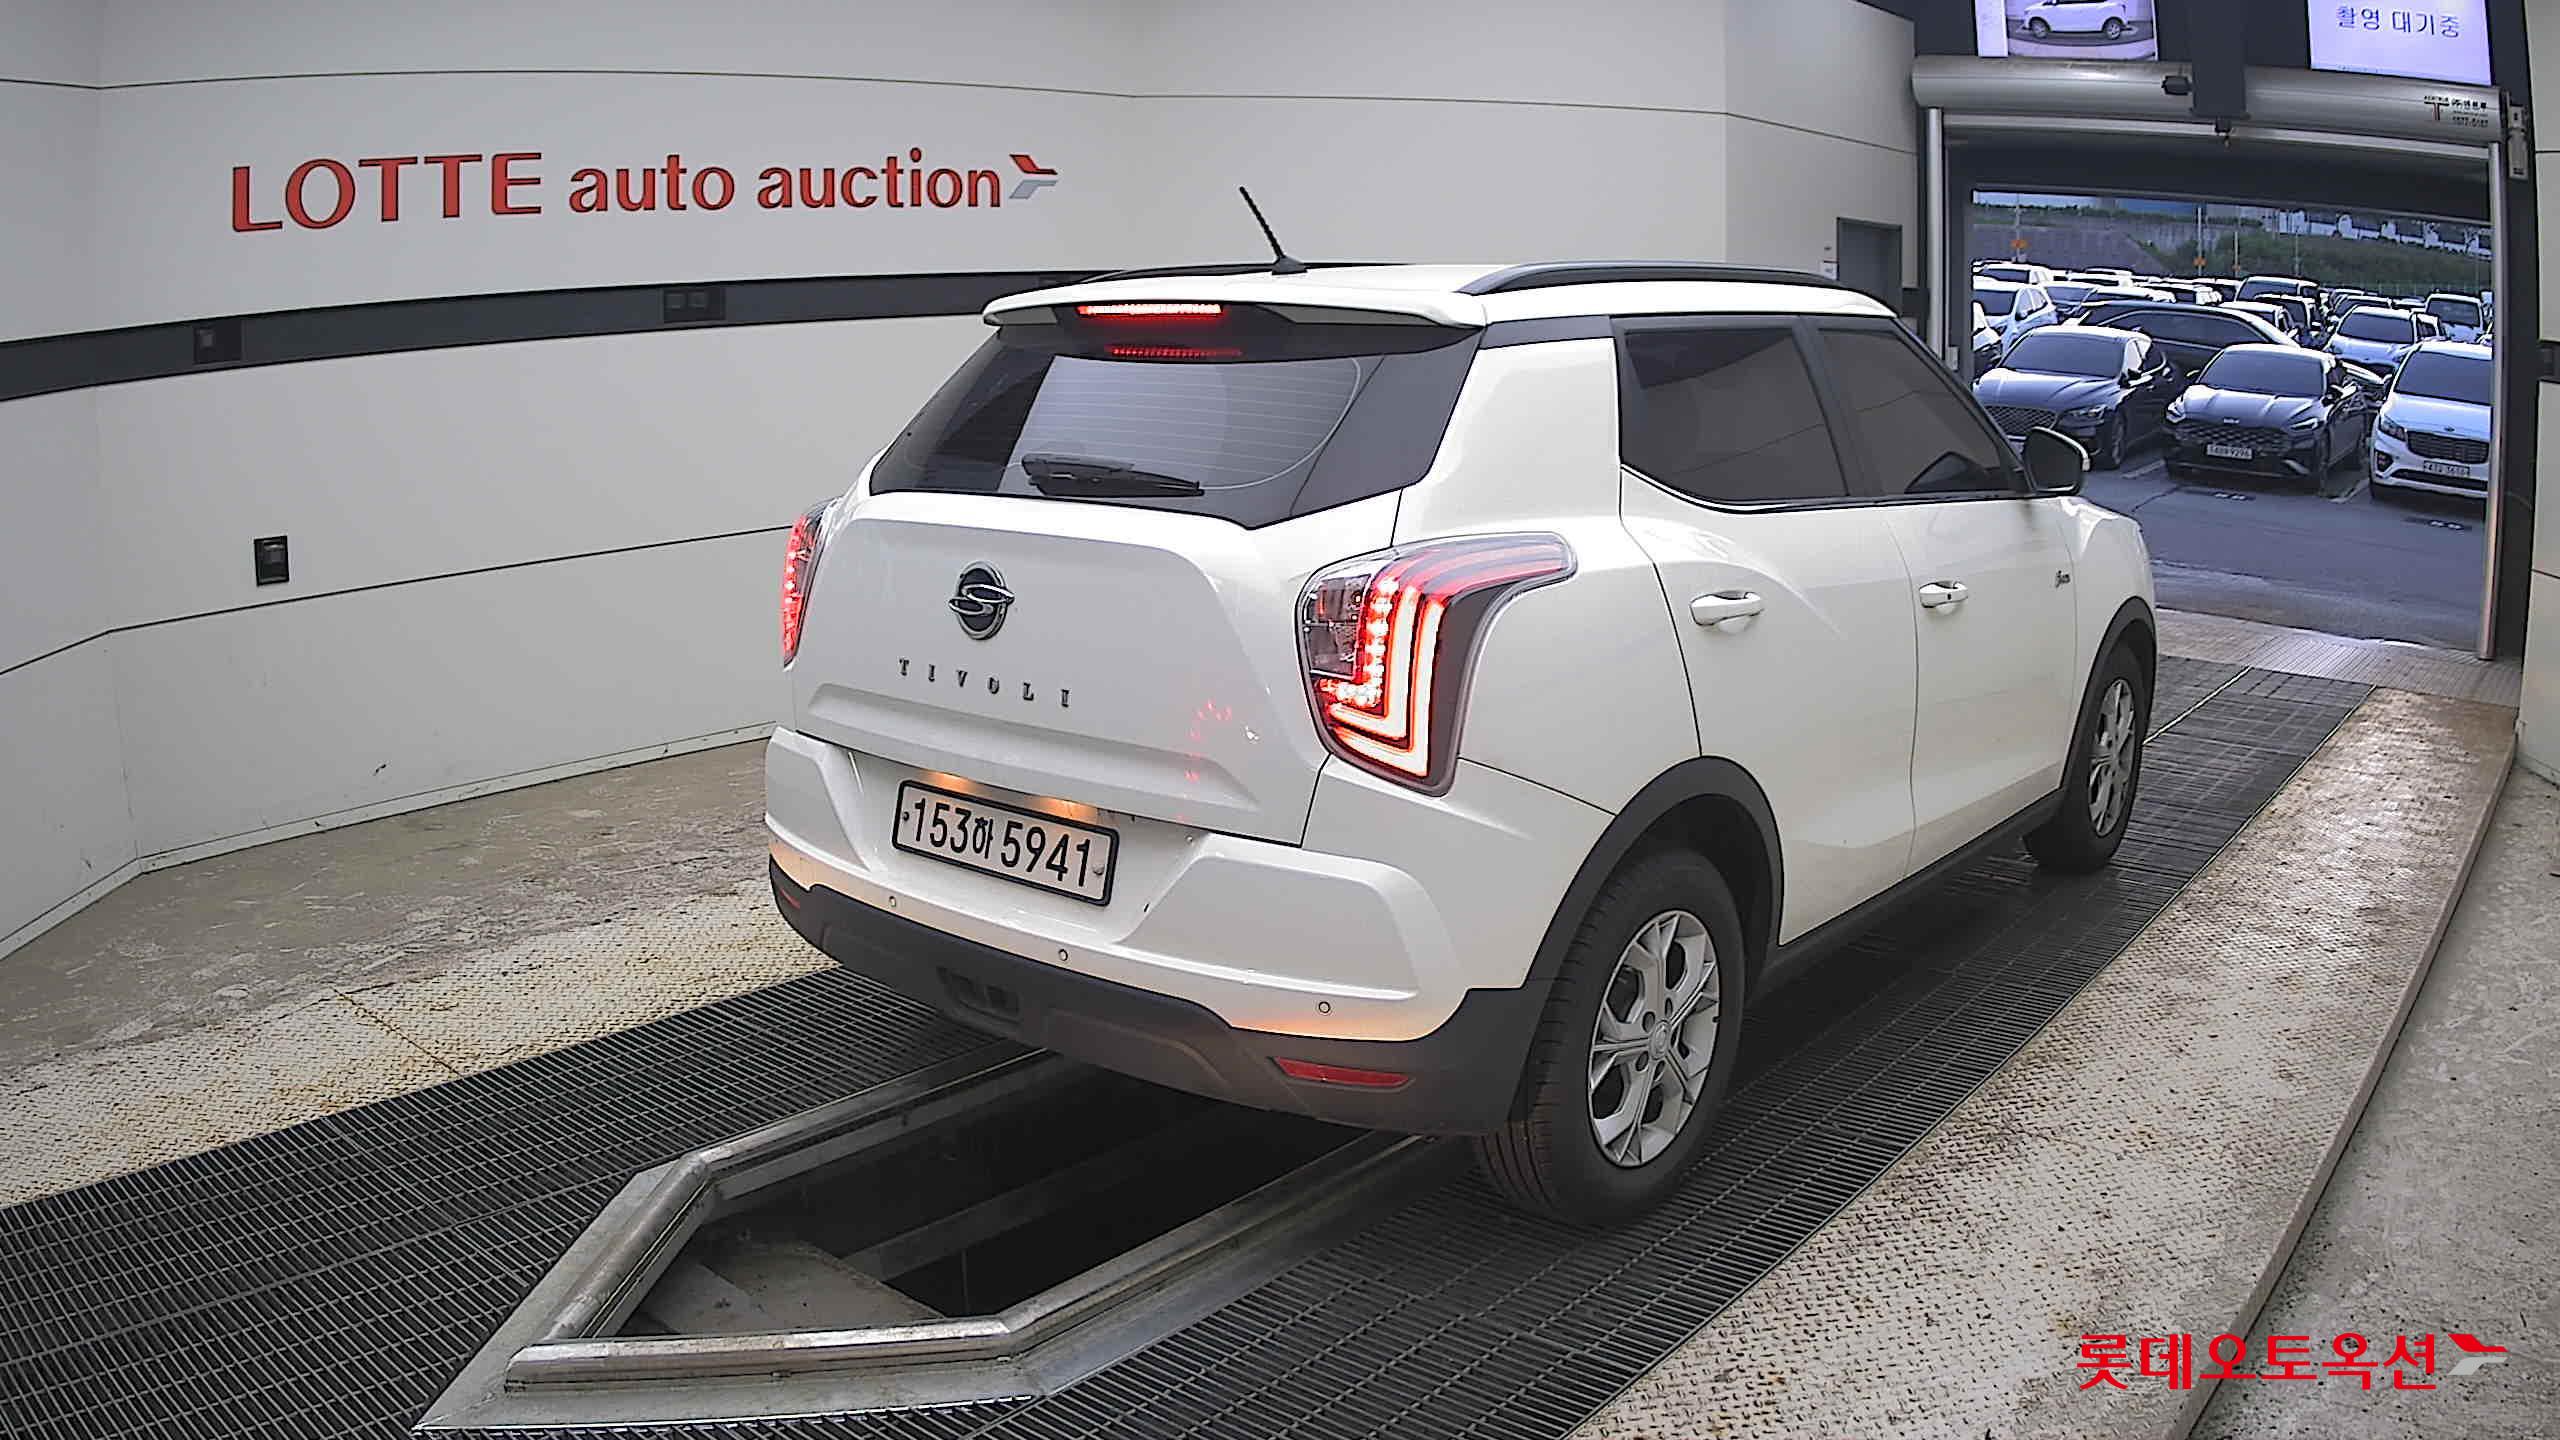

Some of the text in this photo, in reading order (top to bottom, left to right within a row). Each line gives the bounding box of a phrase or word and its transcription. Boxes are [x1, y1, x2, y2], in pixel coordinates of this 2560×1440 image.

[2337, 6, 2460, 39] 촬영 대기중
[232, 147, 1003, 233] LOTTE auto auction
[899, 657, 1071, 709] TIVOLI
